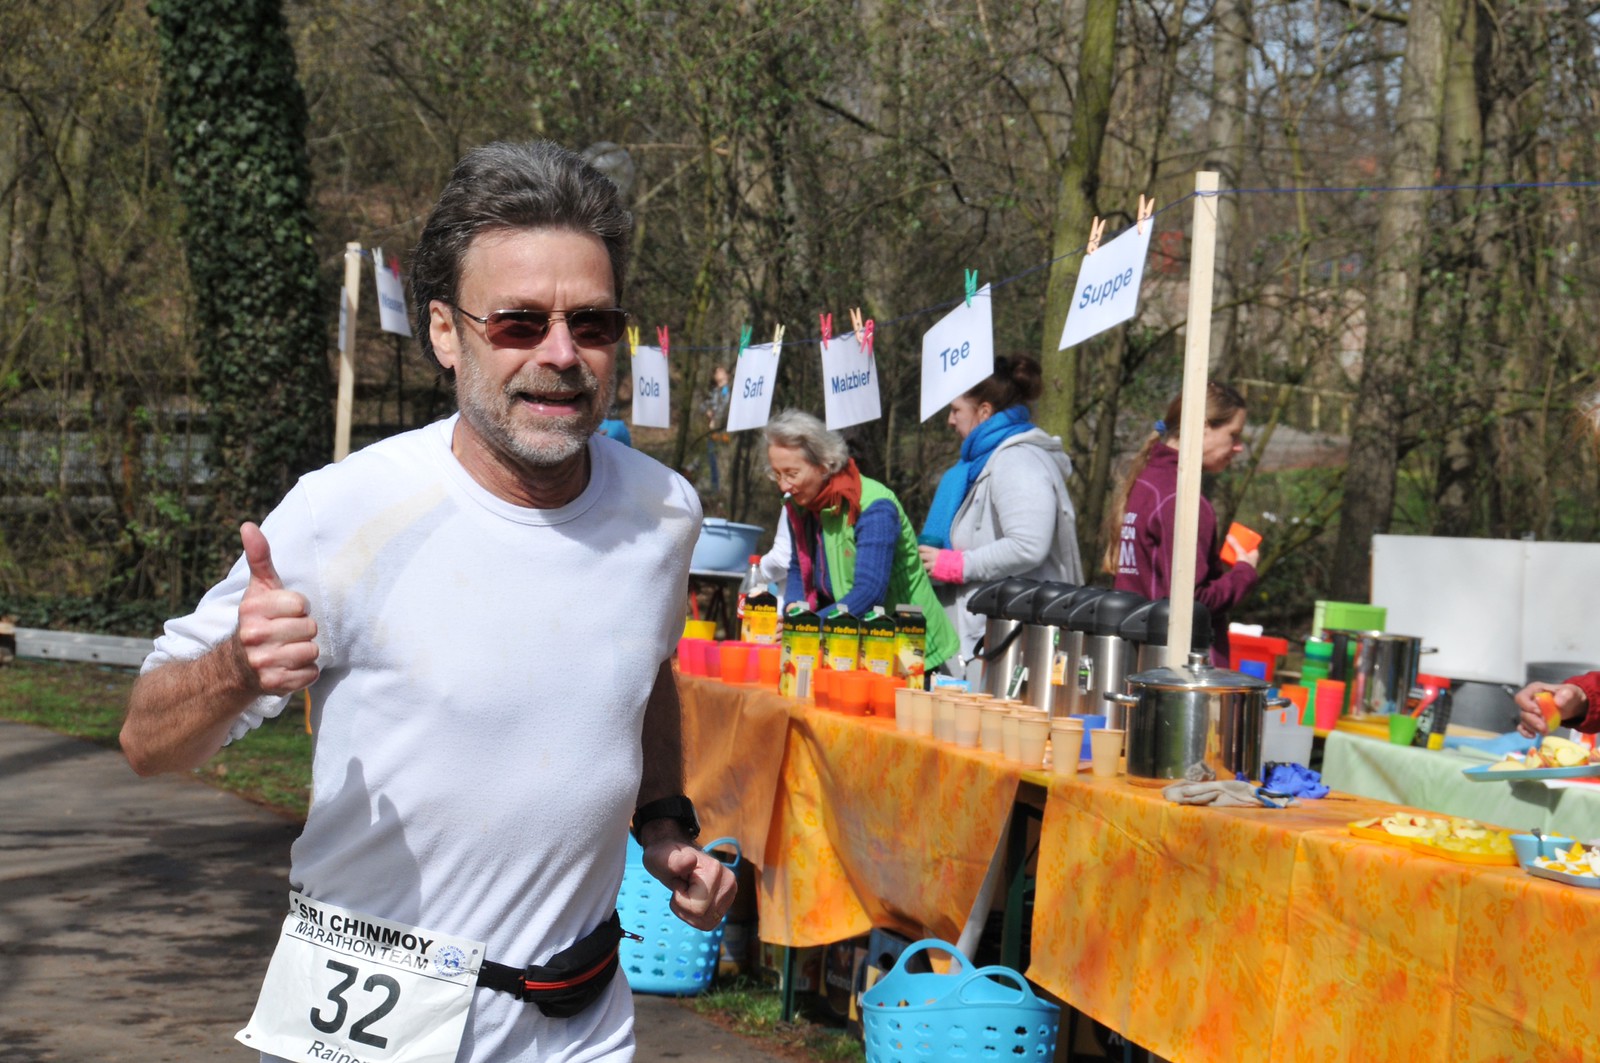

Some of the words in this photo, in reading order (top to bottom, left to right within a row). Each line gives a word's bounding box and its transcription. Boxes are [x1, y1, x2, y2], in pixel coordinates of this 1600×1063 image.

[1079, 267, 1133, 310] Suppe
[939, 340, 970, 373] Tee
[639, 376, 660, 398] Cola
[743, 374, 765, 398] Saft
[831, 370, 870, 395] Malzbier
[299, 902, 324, 927] SRI
[330, 914, 434, 955] CHINMOY
[294, 920, 377, 957] MARATHON
[381, 946, 429, 971] TEAM
[309, 958, 401, 1050] 32
[306, 1039, 370, 1063] Rain
